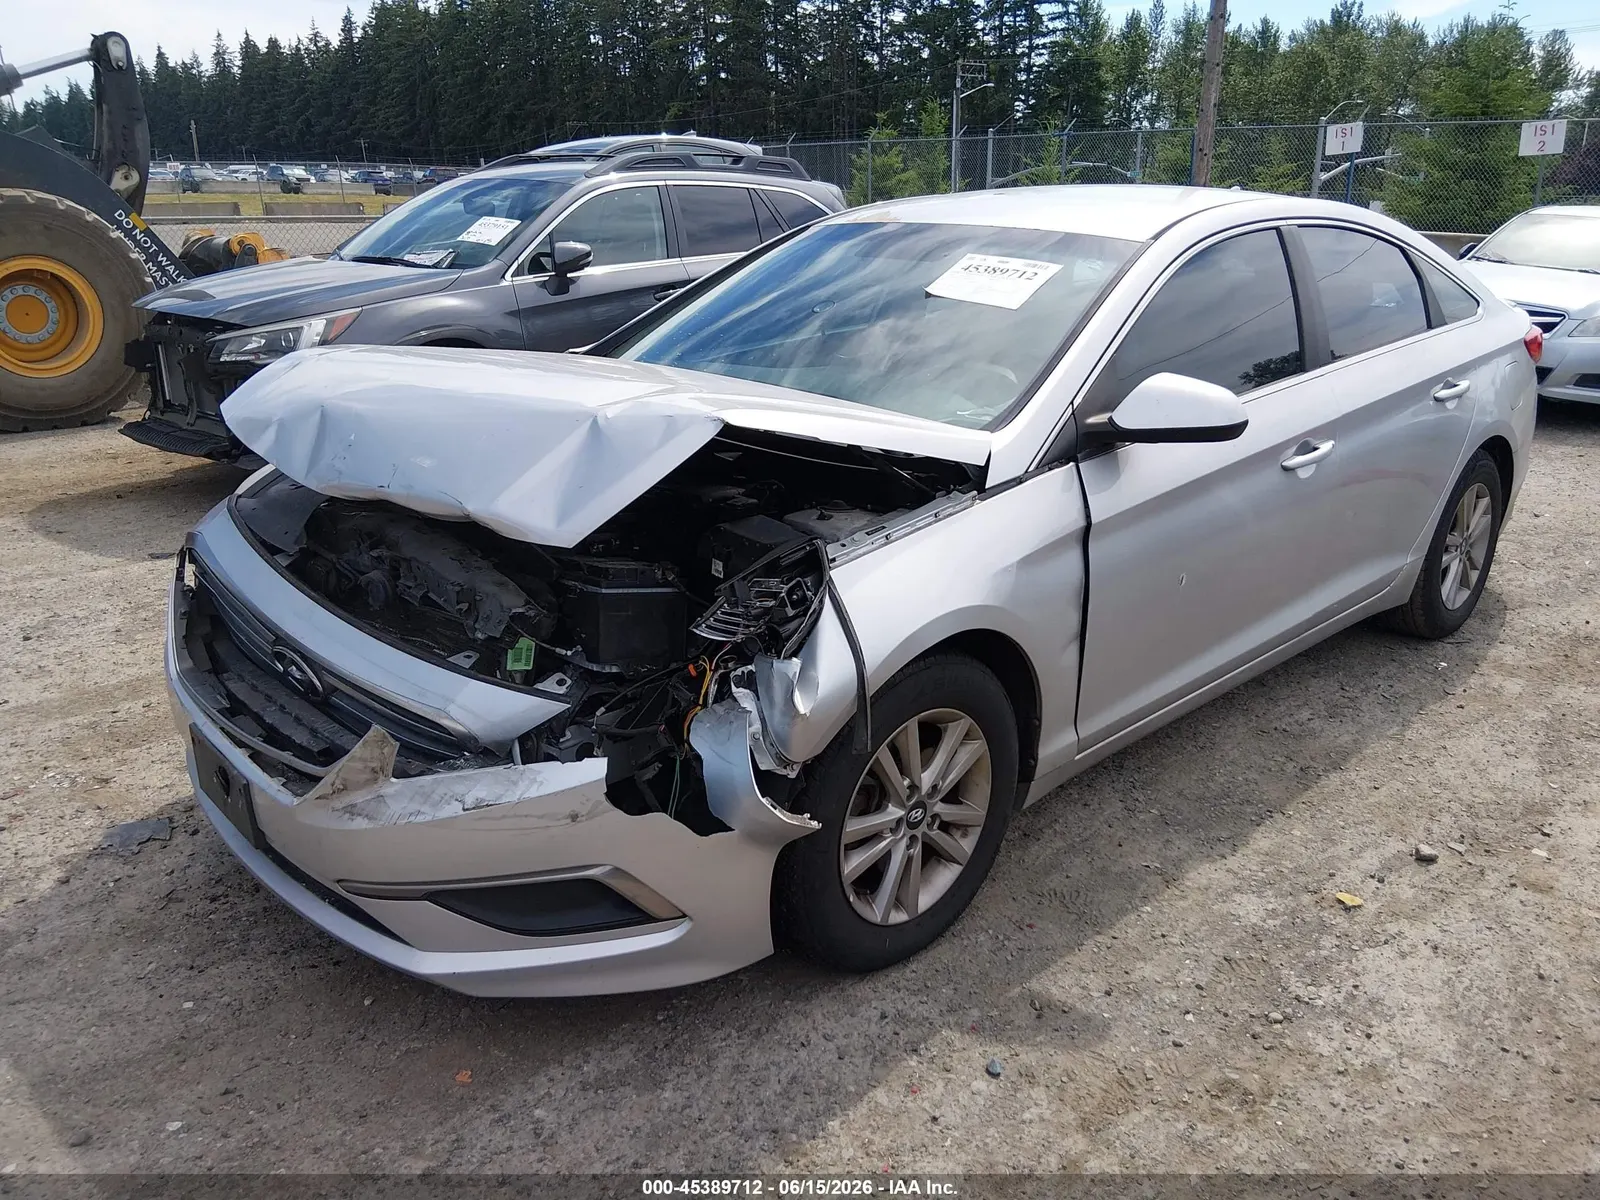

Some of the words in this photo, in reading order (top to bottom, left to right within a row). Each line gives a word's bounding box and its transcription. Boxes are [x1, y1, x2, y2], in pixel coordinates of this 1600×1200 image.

[1537, 140, 1546, 152] 2
[114, 209, 134, 229] DO
[132, 228, 159, 254] NOT
[157, 252, 188, 284] WALK
[961, 263, 1039, 281] 45389712
